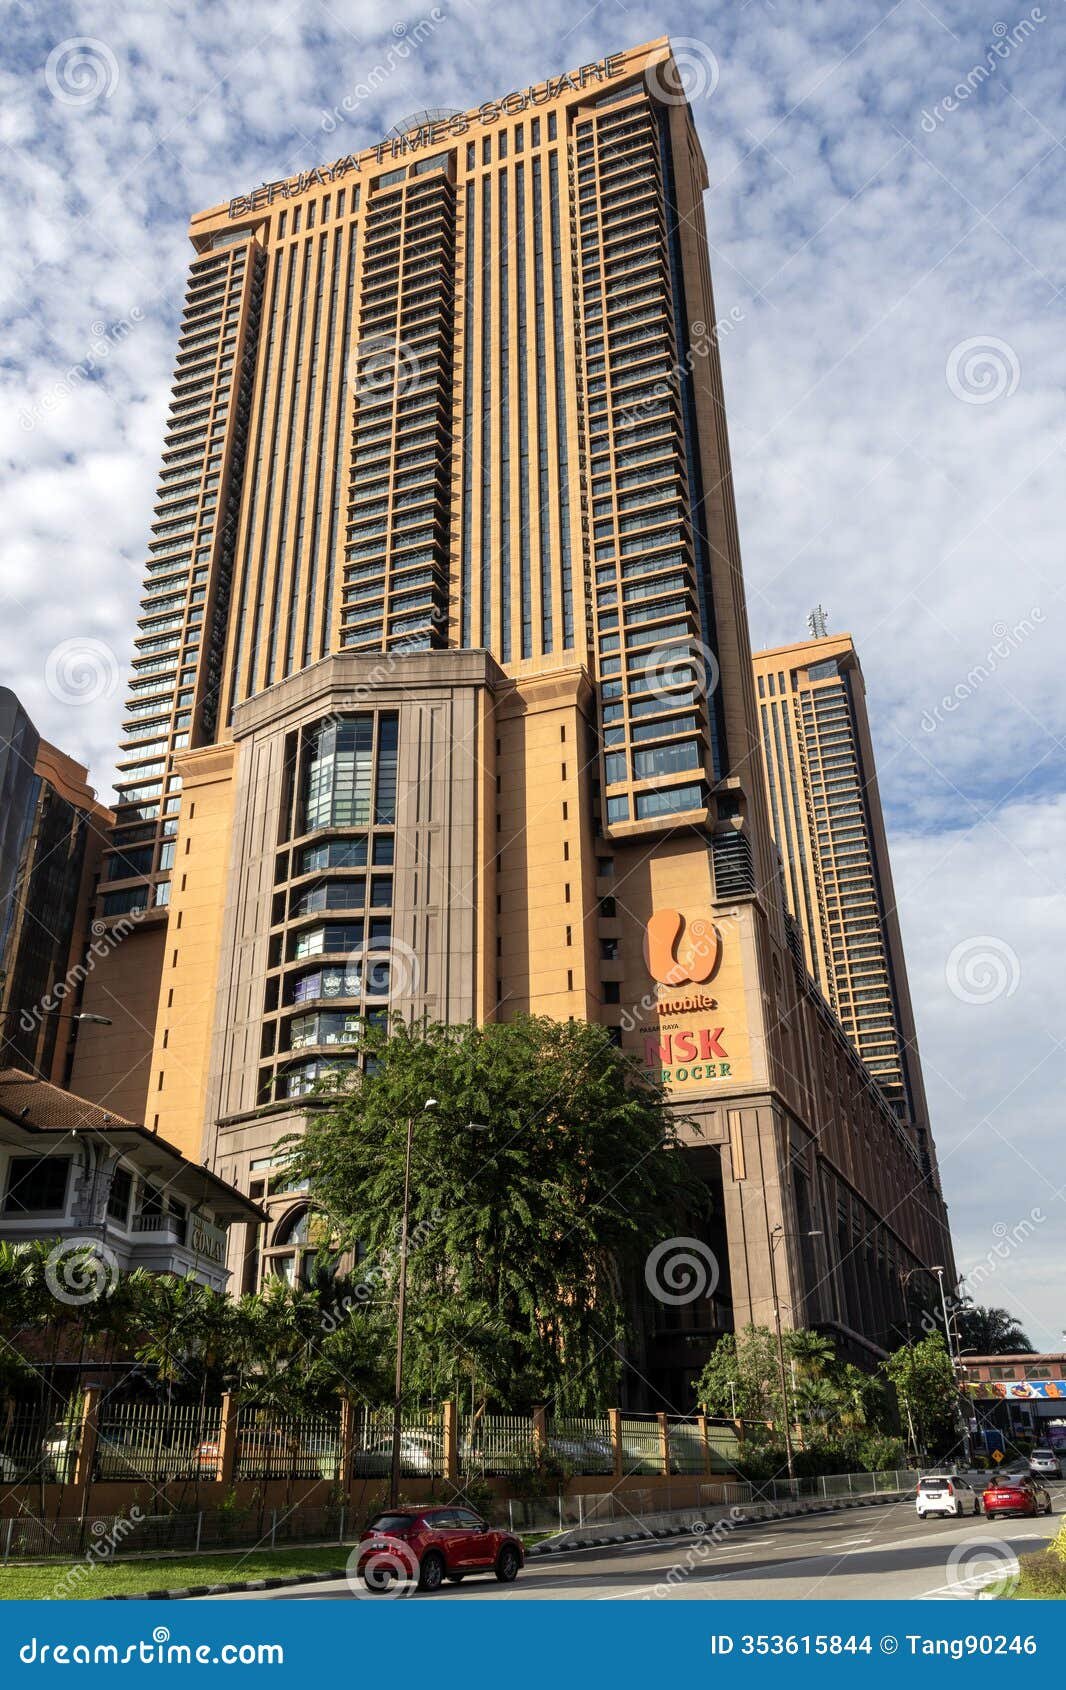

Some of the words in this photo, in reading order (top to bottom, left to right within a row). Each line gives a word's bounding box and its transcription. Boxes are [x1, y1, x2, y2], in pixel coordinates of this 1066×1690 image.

[370, 111, 470, 164] TIMES
[478, 51, 627, 125] SQUARE
[656, 994, 718, 1016] mobile
[662, 1023, 679, 1031] RAYA
[644, 1027, 728, 1067] NSK
